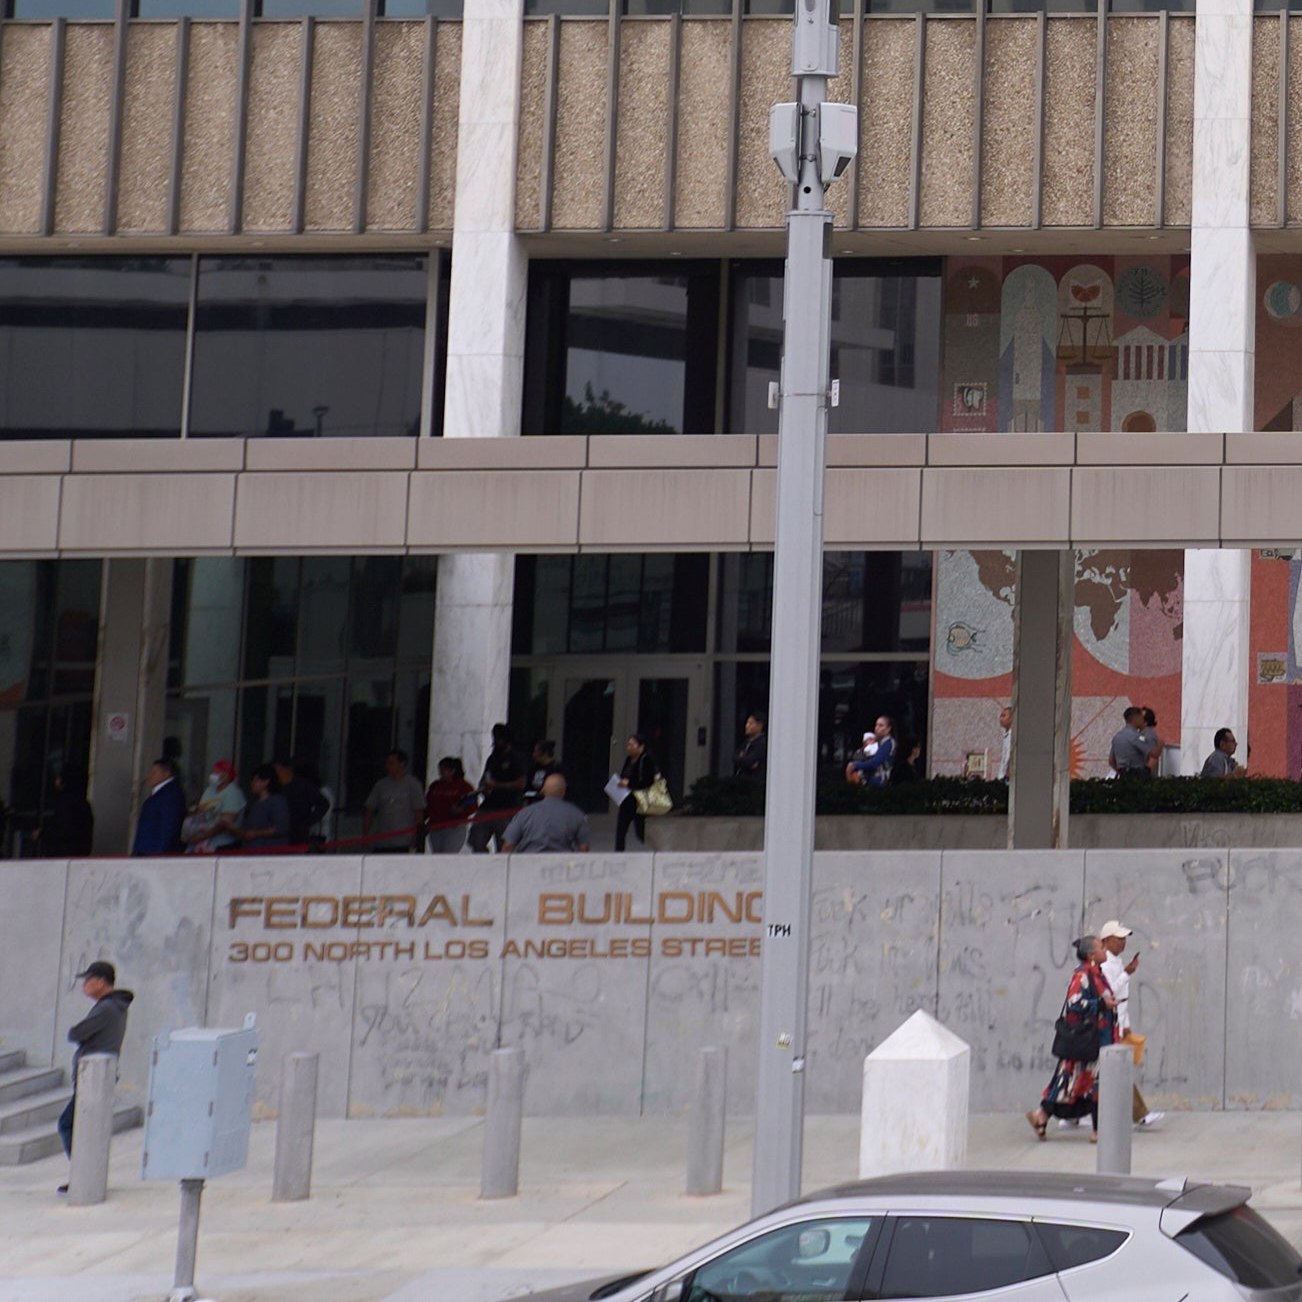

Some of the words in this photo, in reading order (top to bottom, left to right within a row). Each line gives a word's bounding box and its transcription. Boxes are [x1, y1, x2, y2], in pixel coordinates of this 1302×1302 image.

[229, 894, 494, 929] FEDERAL
[768, 923, 791, 938] TPH
[229, 941, 293, 962] 300
[303, 940, 415, 961] NORTH
[424, 940, 489, 960] LOS
[499, 938, 652, 959] ANGELES
[661, 937, 762, 957] STREE
